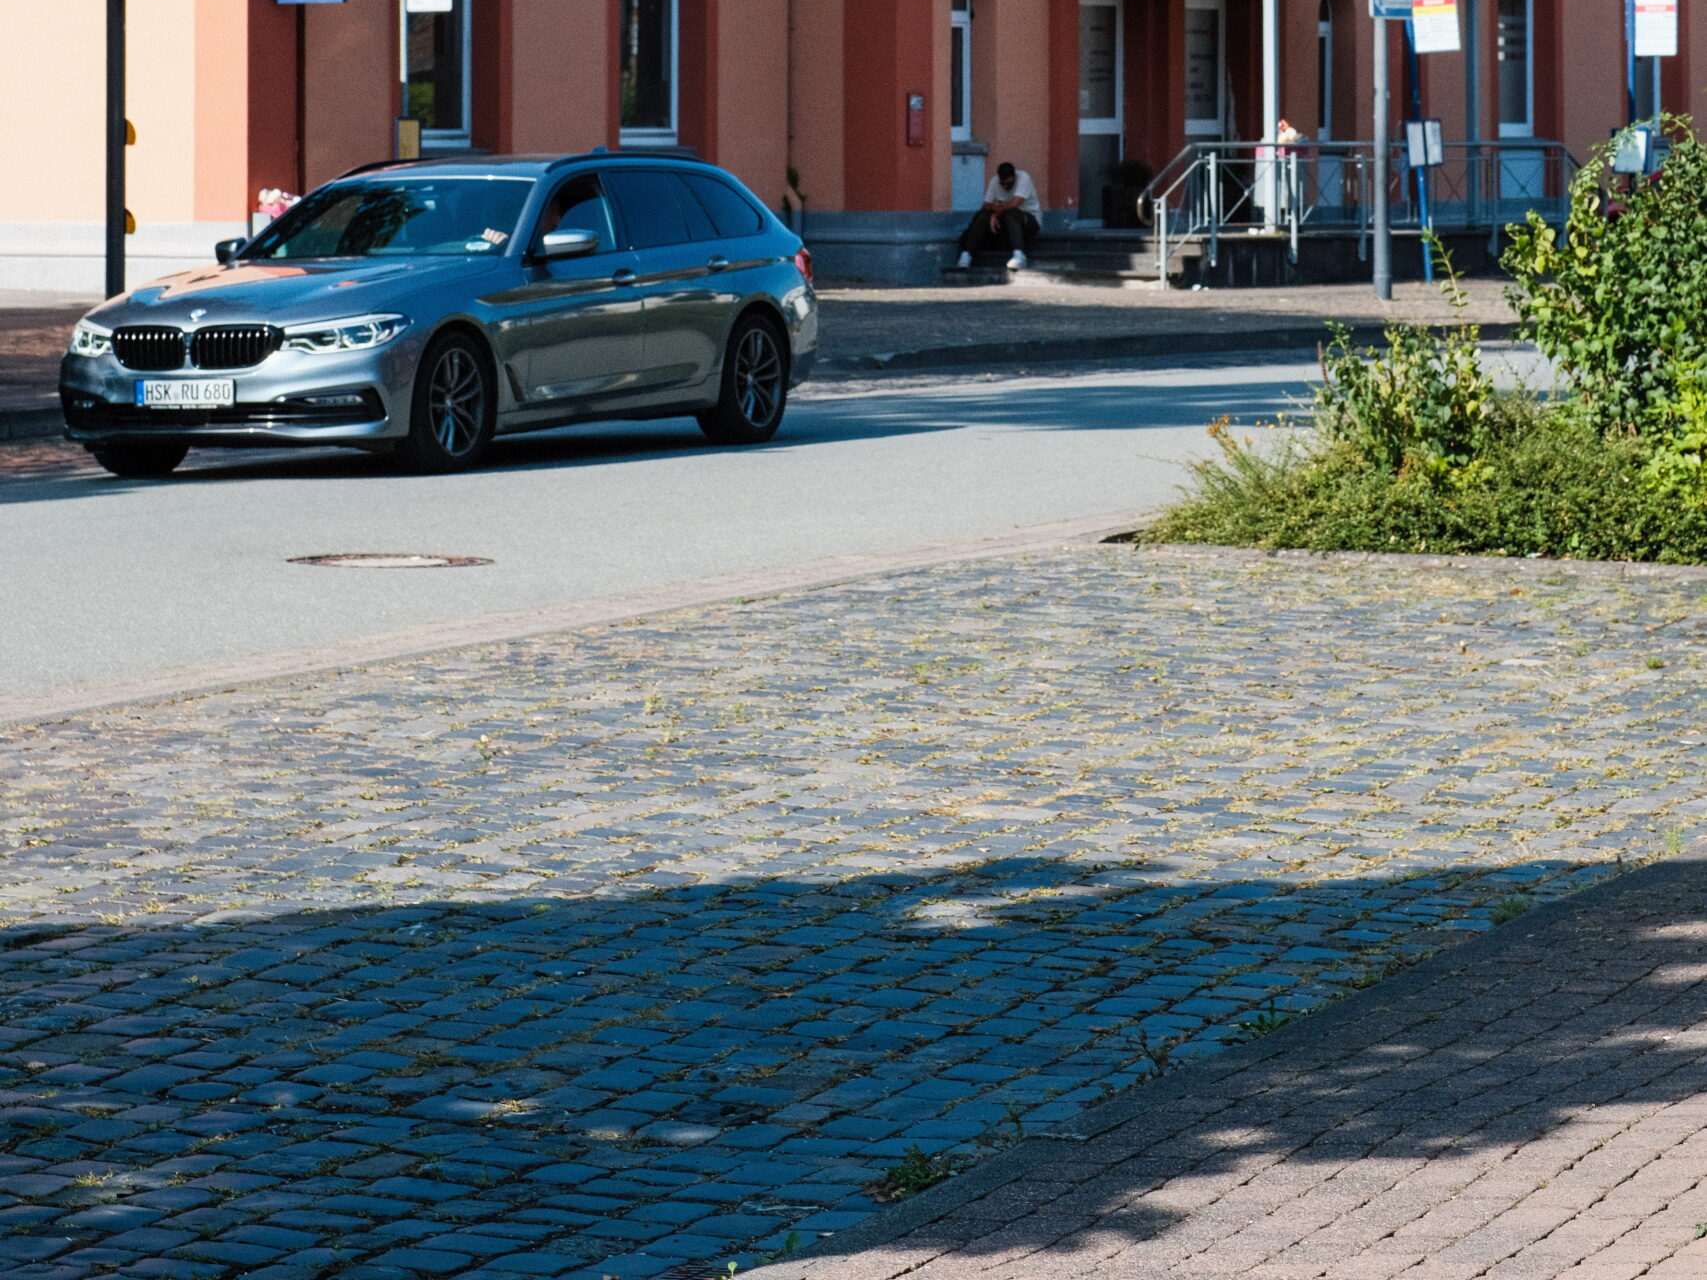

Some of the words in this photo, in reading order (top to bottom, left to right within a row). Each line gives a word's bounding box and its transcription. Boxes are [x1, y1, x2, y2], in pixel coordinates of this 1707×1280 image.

[145, 384, 172, 401] HSK
[181, 383, 199, 401] RU
[203, 383, 231, 400] 680
